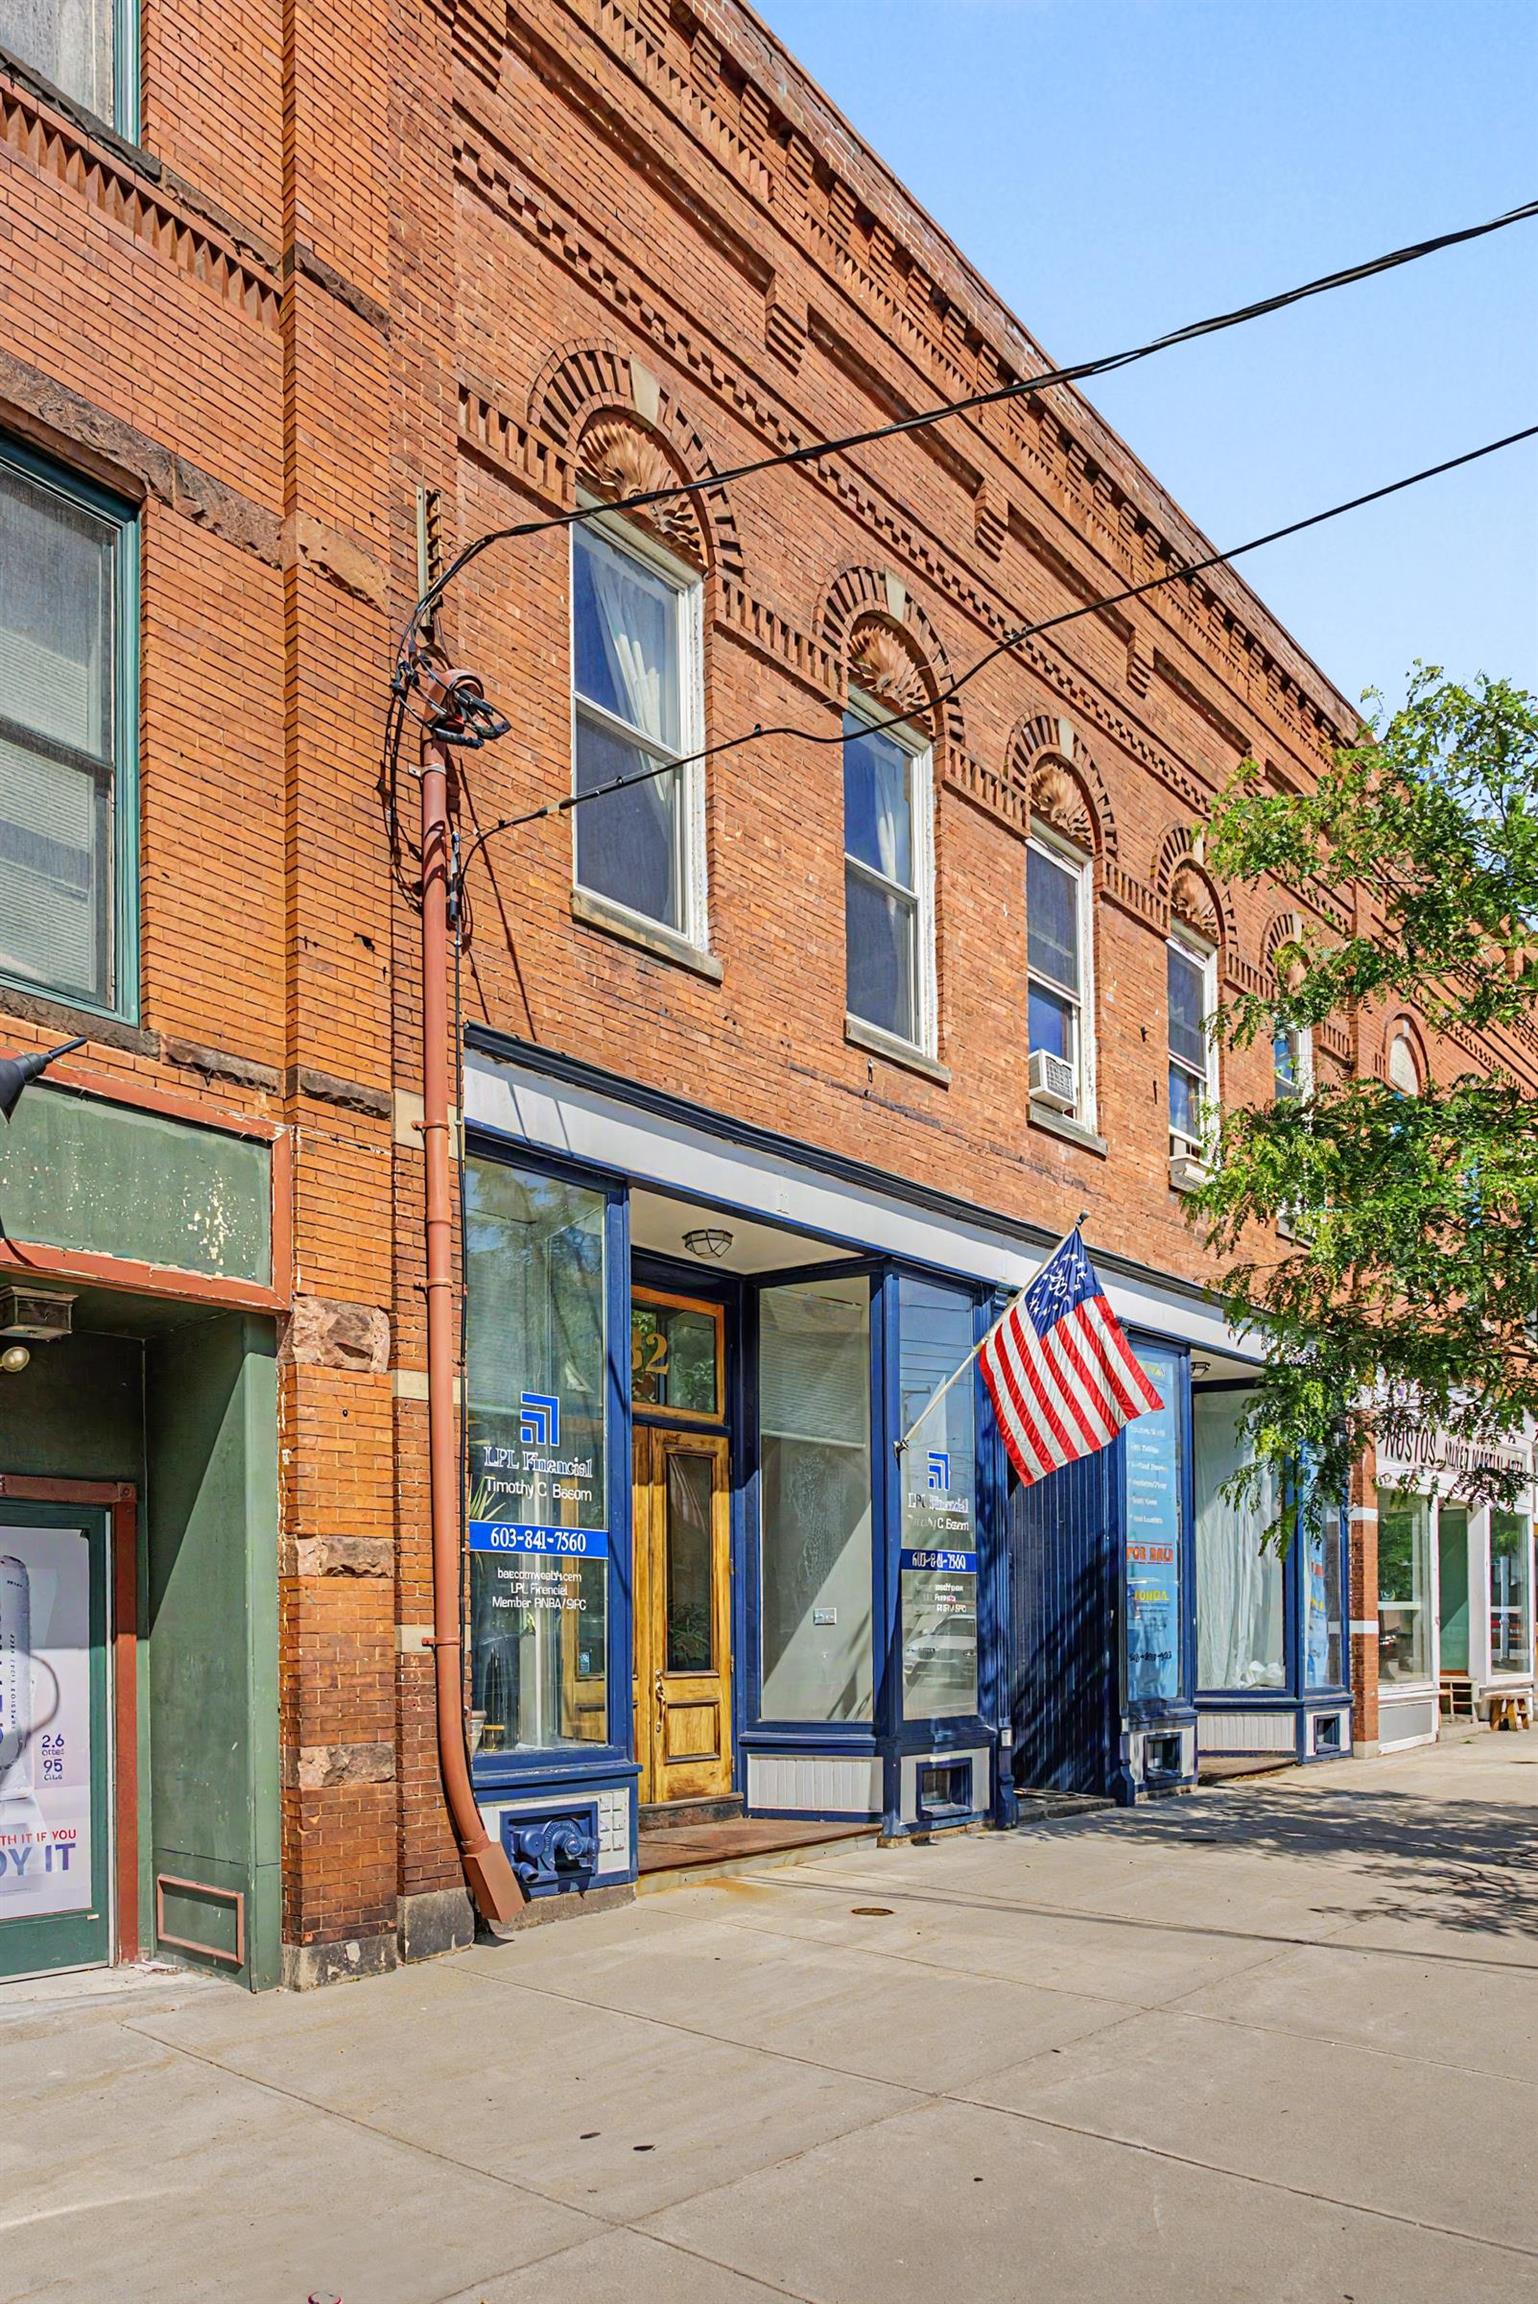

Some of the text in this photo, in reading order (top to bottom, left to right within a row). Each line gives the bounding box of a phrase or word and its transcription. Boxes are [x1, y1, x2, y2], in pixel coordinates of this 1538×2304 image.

[483, 1446, 593, 1479] LPL Financial
[484, 1475, 534, 1500] Timothy
[537, 1481, 548, 1497] C
[490, 1527, 587, 1553] 603-841-7560
[510, 1582, 529, 1595] LPL
[492, 1595, 532, 1608] Member
[42, 1734, 64, 1748] 2.6
[43, 1758, 63, 1773] 95
[21, 1833, 32, 1844] IT
[36, 1832, 47, 1842] IF
[51, 1829, 77, 1840] YOU
[45, 1843, 76, 1873] IT
